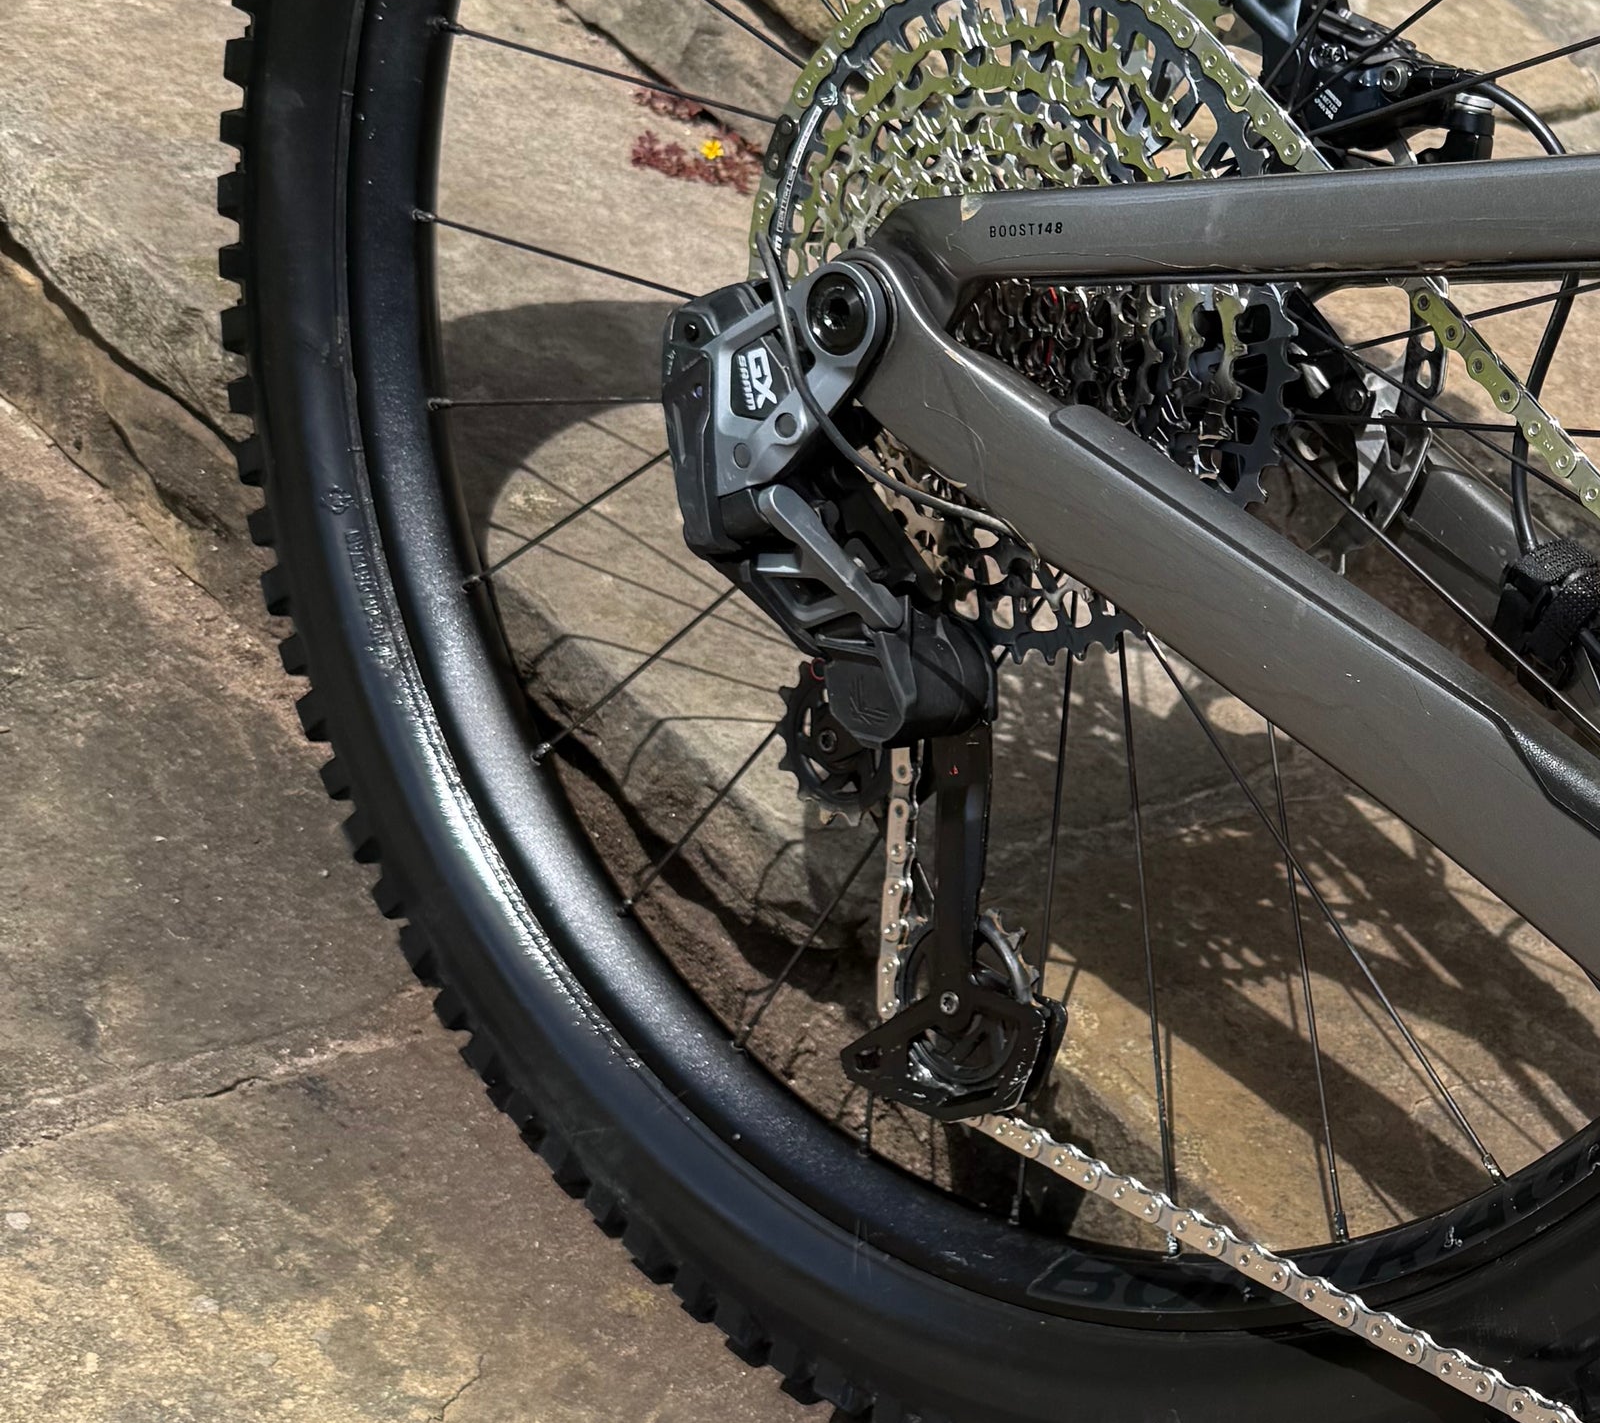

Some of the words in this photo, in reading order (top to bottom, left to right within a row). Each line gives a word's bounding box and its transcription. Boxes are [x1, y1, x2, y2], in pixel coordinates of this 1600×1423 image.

[989, 221, 1064, 238] BOOST148
[737, 354, 757, 411] SRAM
[747, 346, 778, 410] GX
